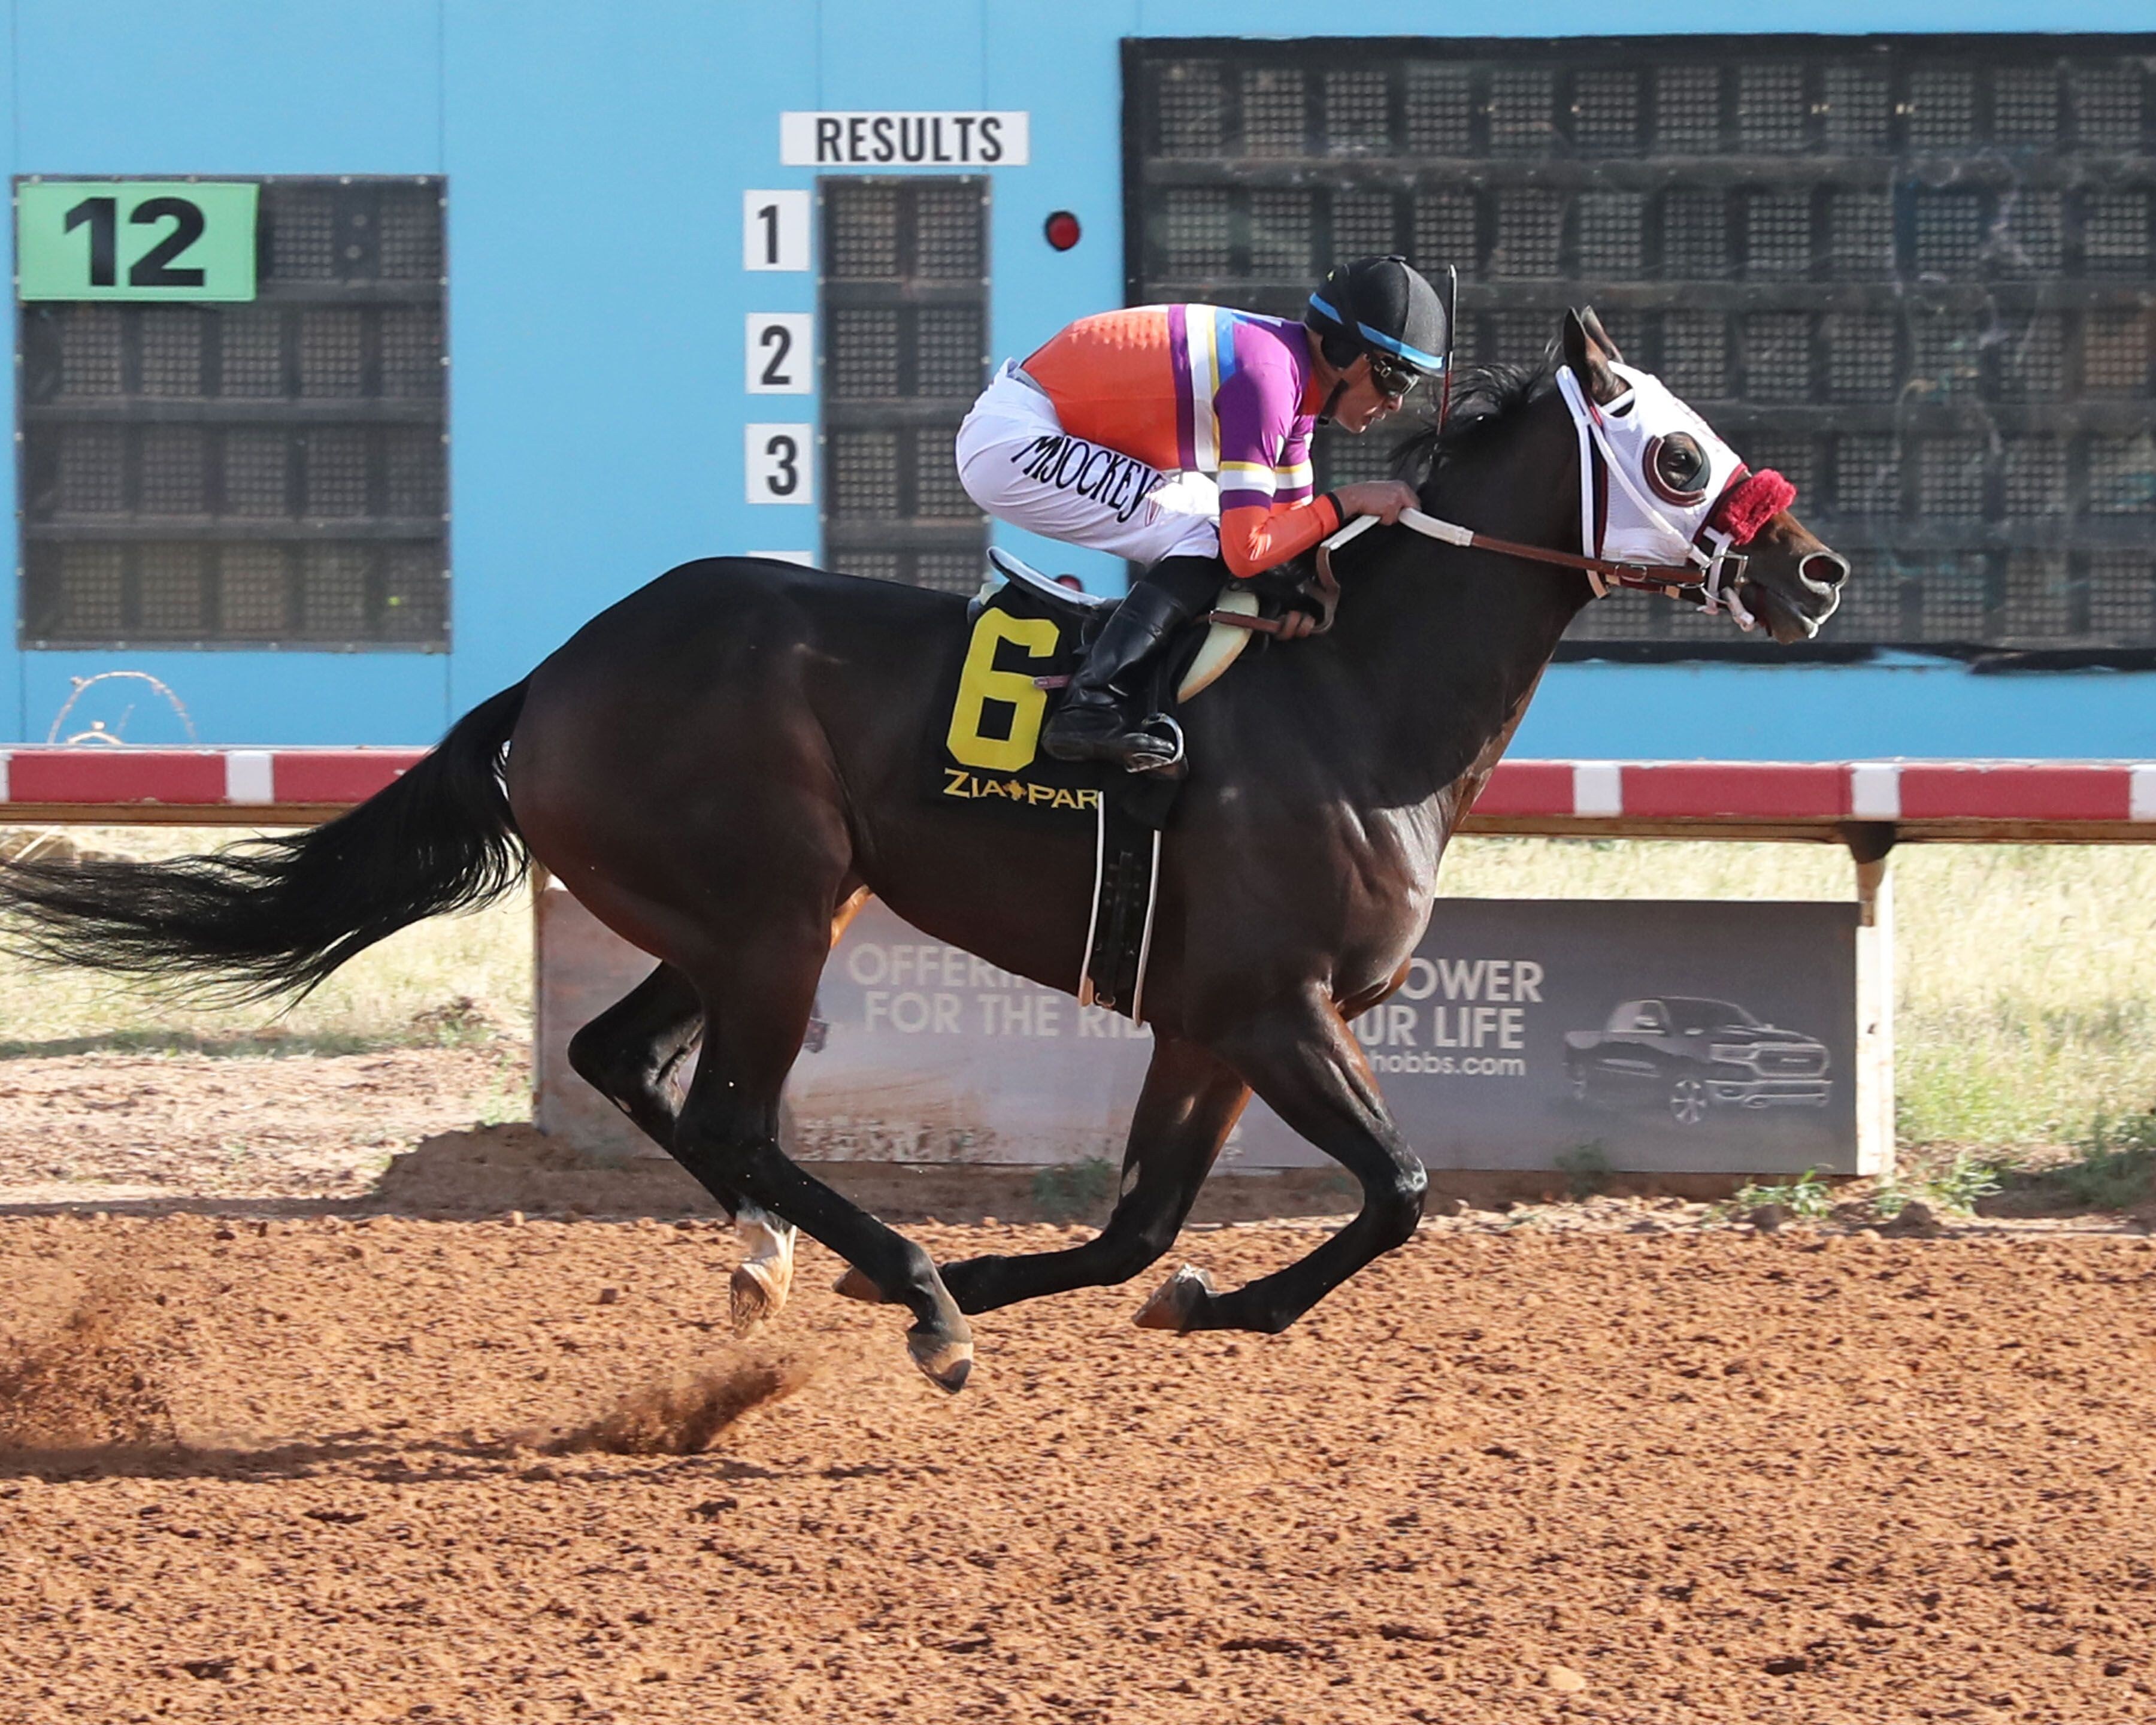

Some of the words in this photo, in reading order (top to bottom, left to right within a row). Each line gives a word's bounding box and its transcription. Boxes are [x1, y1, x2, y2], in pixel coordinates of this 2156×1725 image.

[816, 117, 1003, 163] RESULTS
[63, 196, 206, 288] 12
[758, 205, 779, 264] 1
[761, 325, 791, 385] 2
[767, 435, 798, 496] 3
[946, 606, 1060, 773] 6
[943, 767, 1007, 799] ZIA
[1027, 782, 1100, 810] PAR
[849, 943, 1026, 988] OFFER
[1400, 957, 1545, 1003] OWER
[865, 991, 961, 1034] FOR
[976, 993, 1061, 1037] THE
[1350, 1004, 1418, 1047] UR
[1433, 1006, 1525, 1049] LIFE
[1367, 1051, 1526, 1076] hobbs.com
